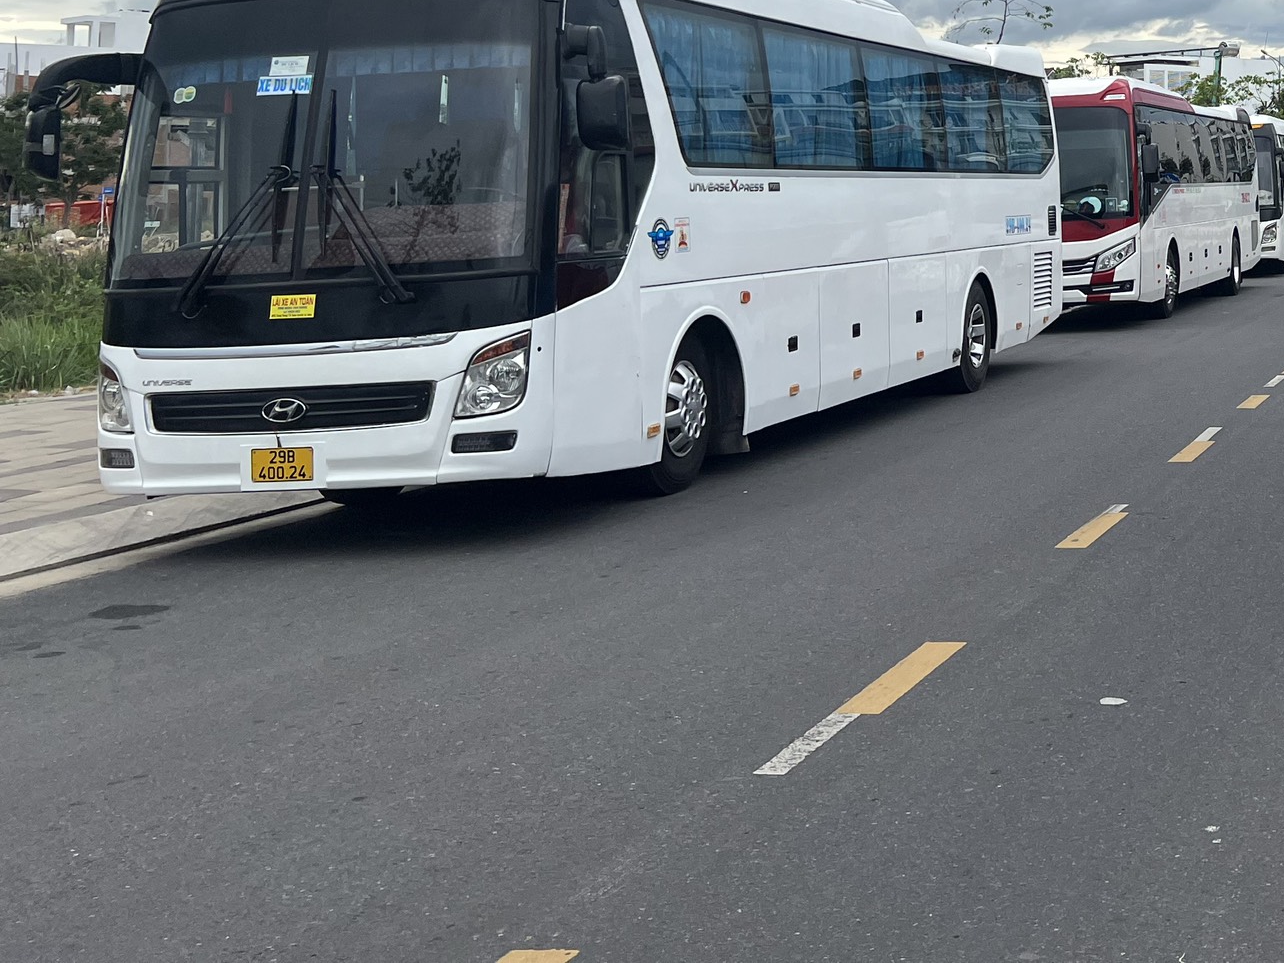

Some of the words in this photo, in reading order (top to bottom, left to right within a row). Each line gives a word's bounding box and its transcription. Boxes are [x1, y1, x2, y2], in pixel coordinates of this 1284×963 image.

[257, 78, 272, 93] XE
[273, 78, 287, 92] DU
[281, 298, 289, 306] XE
[290, 297, 298, 306] AN
[269, 450, 295, 464] 29B
[258, 465, 307, 480] 400.24
